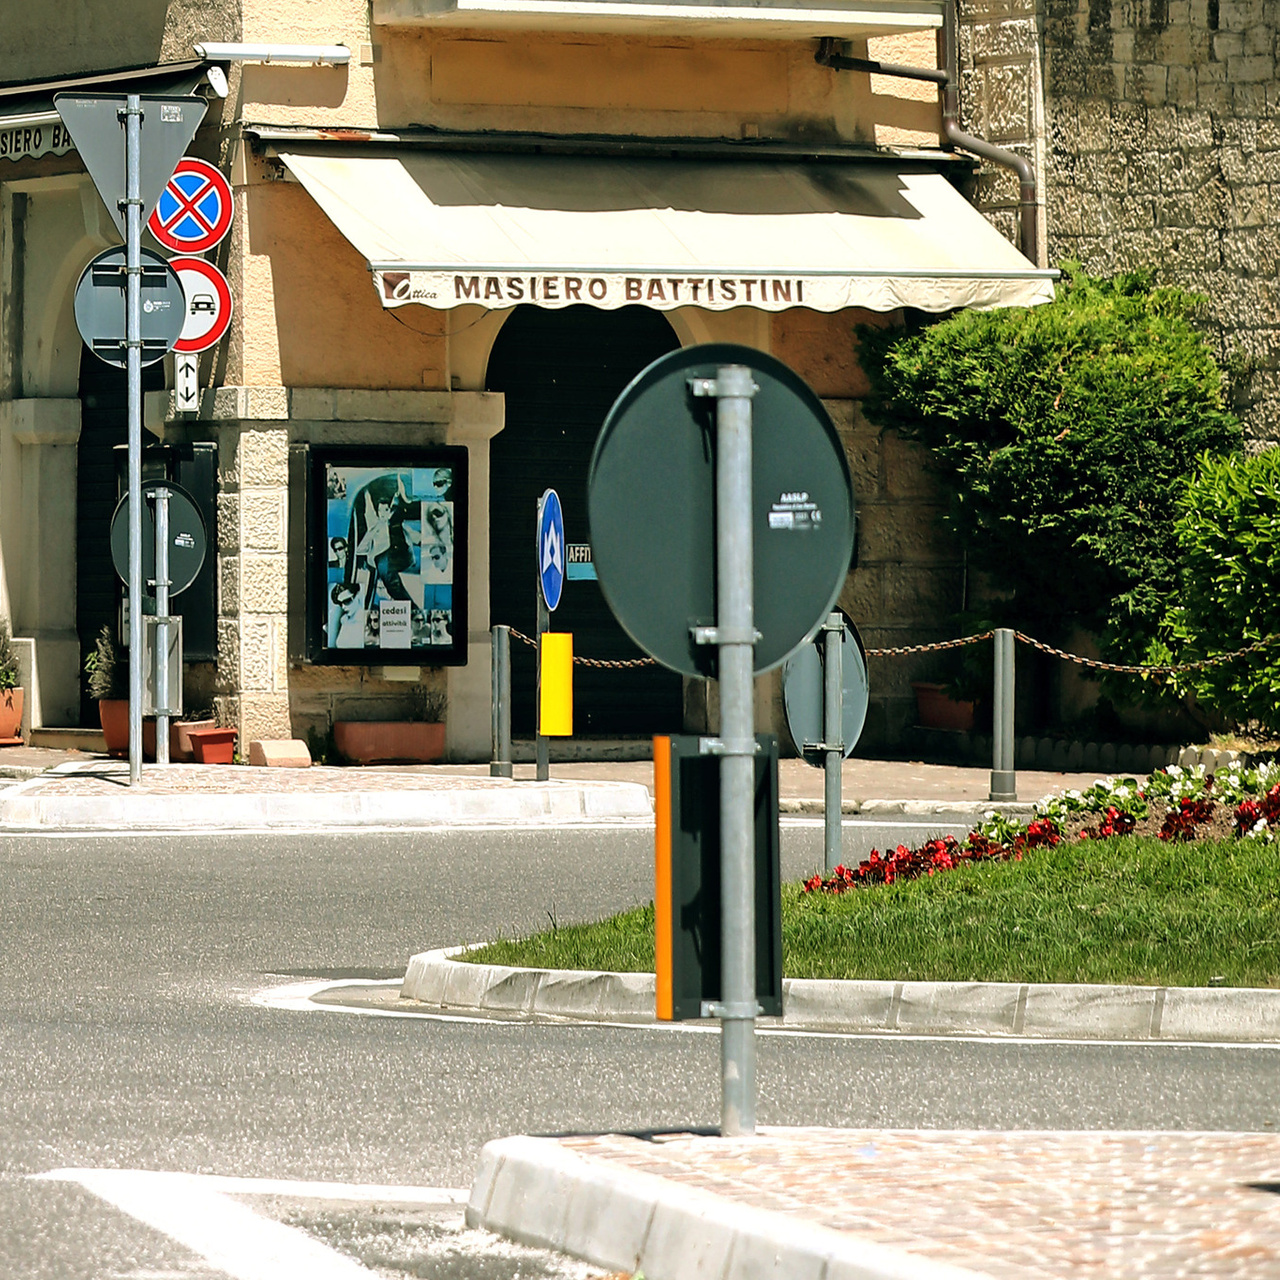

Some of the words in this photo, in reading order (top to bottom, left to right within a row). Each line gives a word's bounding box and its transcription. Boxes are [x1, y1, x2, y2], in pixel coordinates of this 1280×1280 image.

[393, 278, 438, 300] Ottica
[454, 275, 608, 301] MASIERO
[625, 276, 803, 303] BATTISTINI
[381, 606, 407, 615] cedesi
